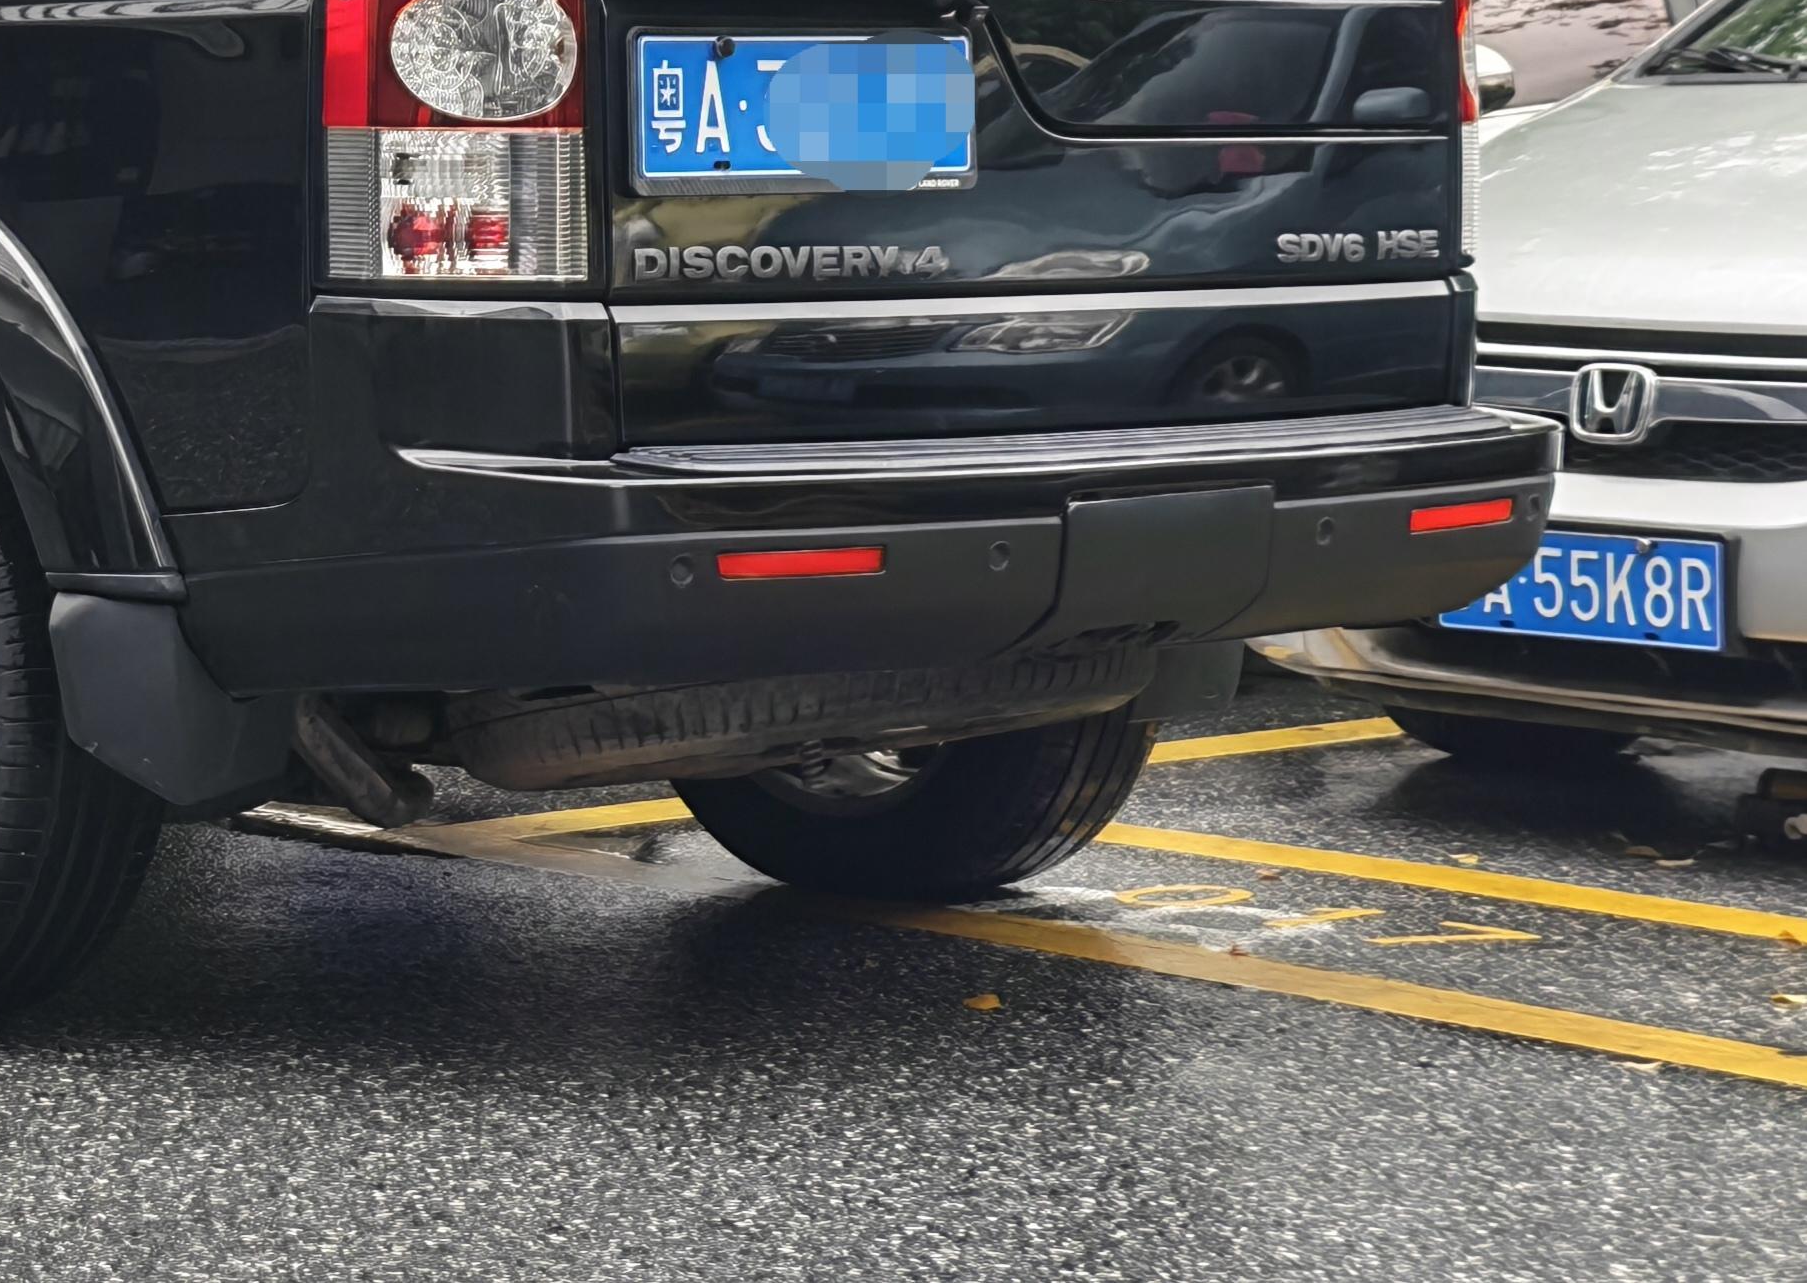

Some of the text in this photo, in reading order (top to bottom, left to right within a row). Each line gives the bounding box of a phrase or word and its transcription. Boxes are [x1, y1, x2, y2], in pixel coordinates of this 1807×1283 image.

[634, 246, 950, 280] DISCOVERY 4
[1277, 229, 1440, 263] SDV6 HSE
